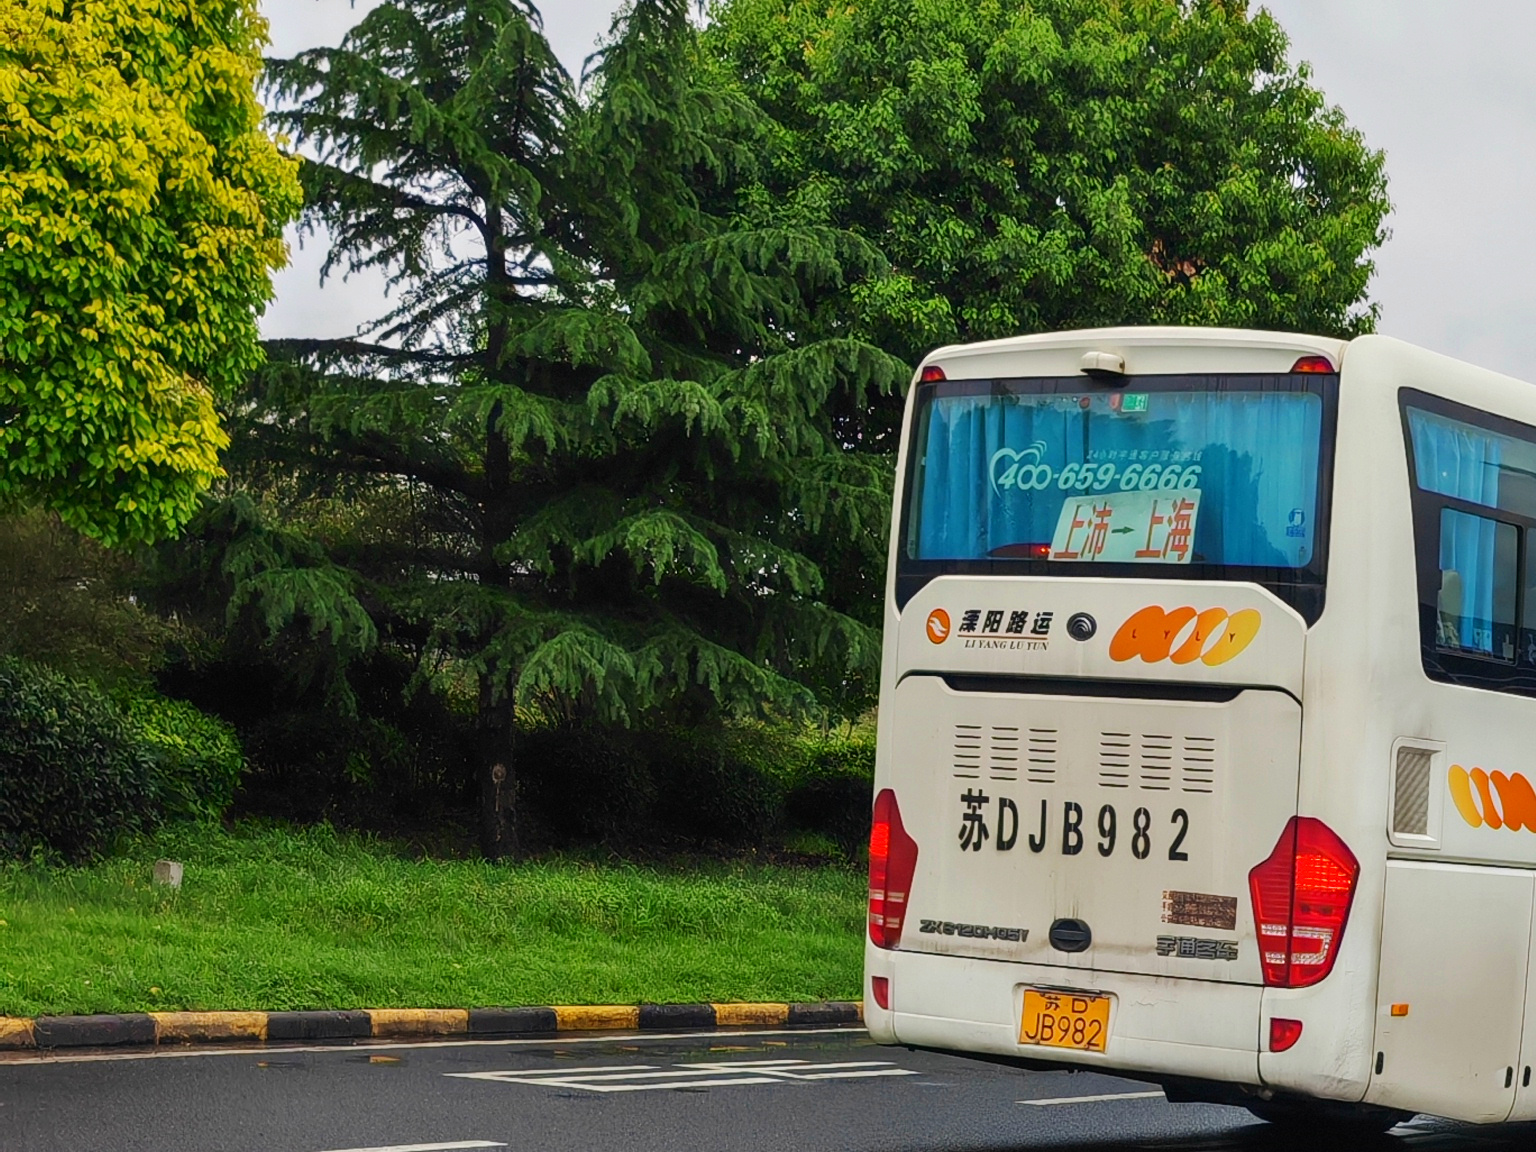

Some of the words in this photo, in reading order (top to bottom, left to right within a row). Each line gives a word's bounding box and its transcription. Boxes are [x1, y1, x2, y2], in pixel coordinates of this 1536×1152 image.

[998, 462, 1202, 491] 400-659-6666
[1135, 498, 1195, 561] 上海
[978, 641, 1007, 650] YANG
[958, 788, 1189, 861] 苏DJB982
[1025, 1013, 1101, 1047] JB982
